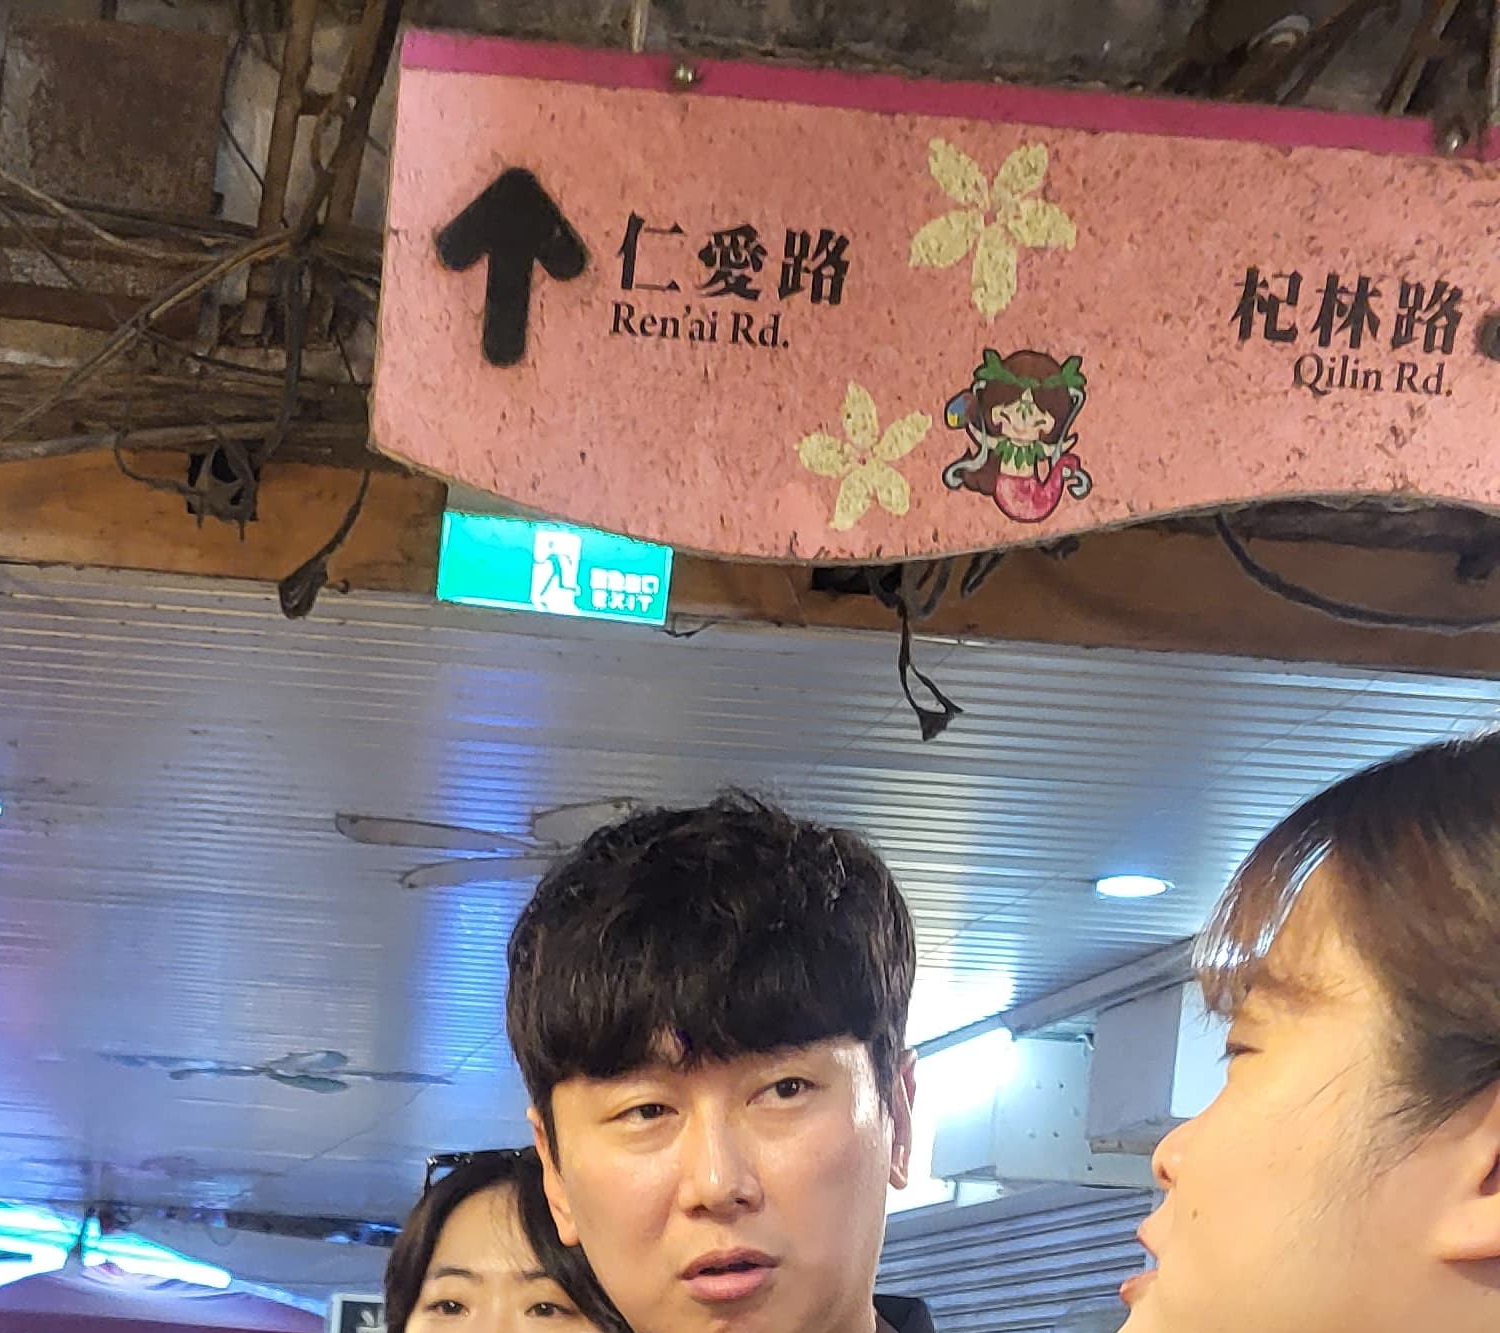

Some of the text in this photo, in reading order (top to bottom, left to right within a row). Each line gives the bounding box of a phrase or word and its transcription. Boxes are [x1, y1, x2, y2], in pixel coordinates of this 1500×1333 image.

[617, 209, 850, 305] 仁愛路
[609, 300, 789, 349] Ren'ai Rd.
[1228, 264, 1464, 355] 杞林路
[1294, 352, 1453, 397] Qilin Rd.
[591, 590, 654, 613] EXIT
